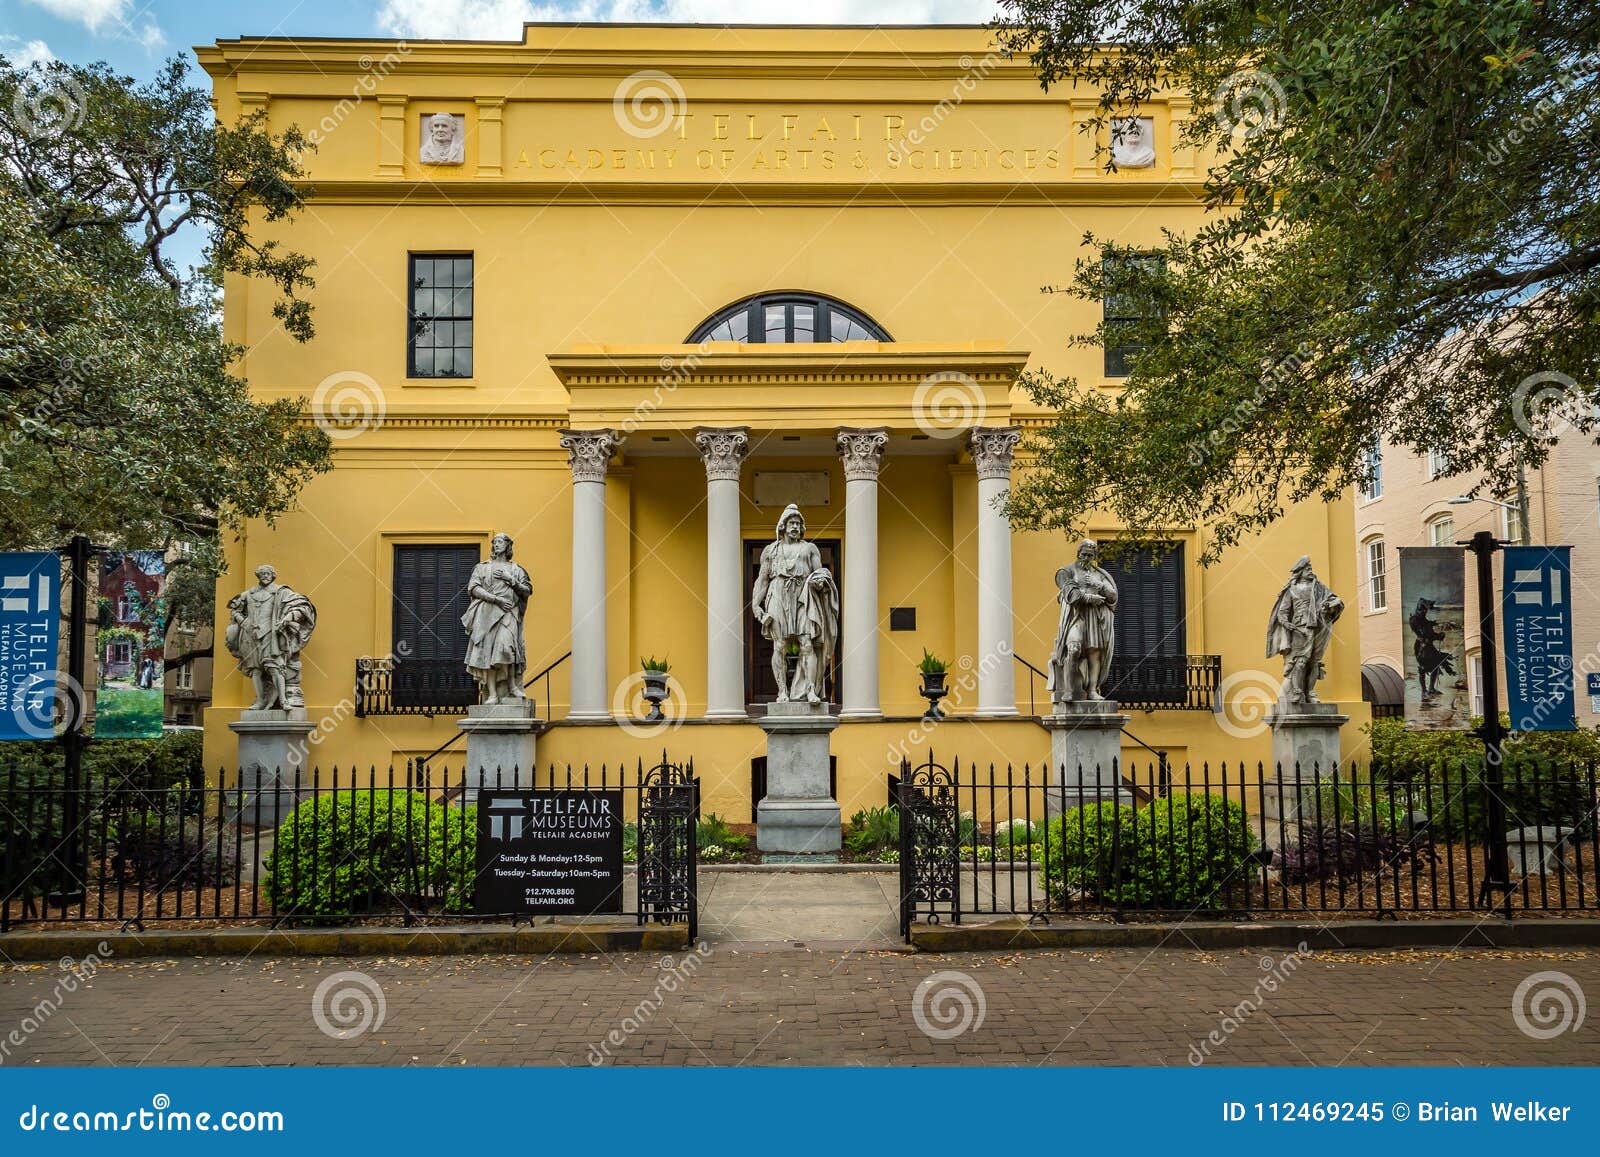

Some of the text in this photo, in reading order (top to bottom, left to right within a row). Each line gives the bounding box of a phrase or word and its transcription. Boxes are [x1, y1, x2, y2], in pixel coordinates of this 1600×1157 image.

[672, 114, 909, 141] TELFAIR
[513, 148, 1061, 170] ACADEMY OF ARTS & SCIENCES
[27, 618, 48, 711] TELFAIR
[1515, 616, 1528, 702] TELFAIR ACADEMY
[1529, 615, 1546, 704] MUSEUMS
[1546, 611, 1565, 701] TELFAIR
[11, 622, 29, 713] MUSEUMS
[529, 798, 611, 815] TELFAIR
[532, 815, 611, 829] MUSEUMS
[532, 831, 611, 839] TELFAIR ACADEMY
[500, 854, 529, 863] Sunday
[529, 854, 537, 862] &
[525, 888, 575, 896] 912.790.8800
[525, 897, 575, 905] TELFAIR.ORG
